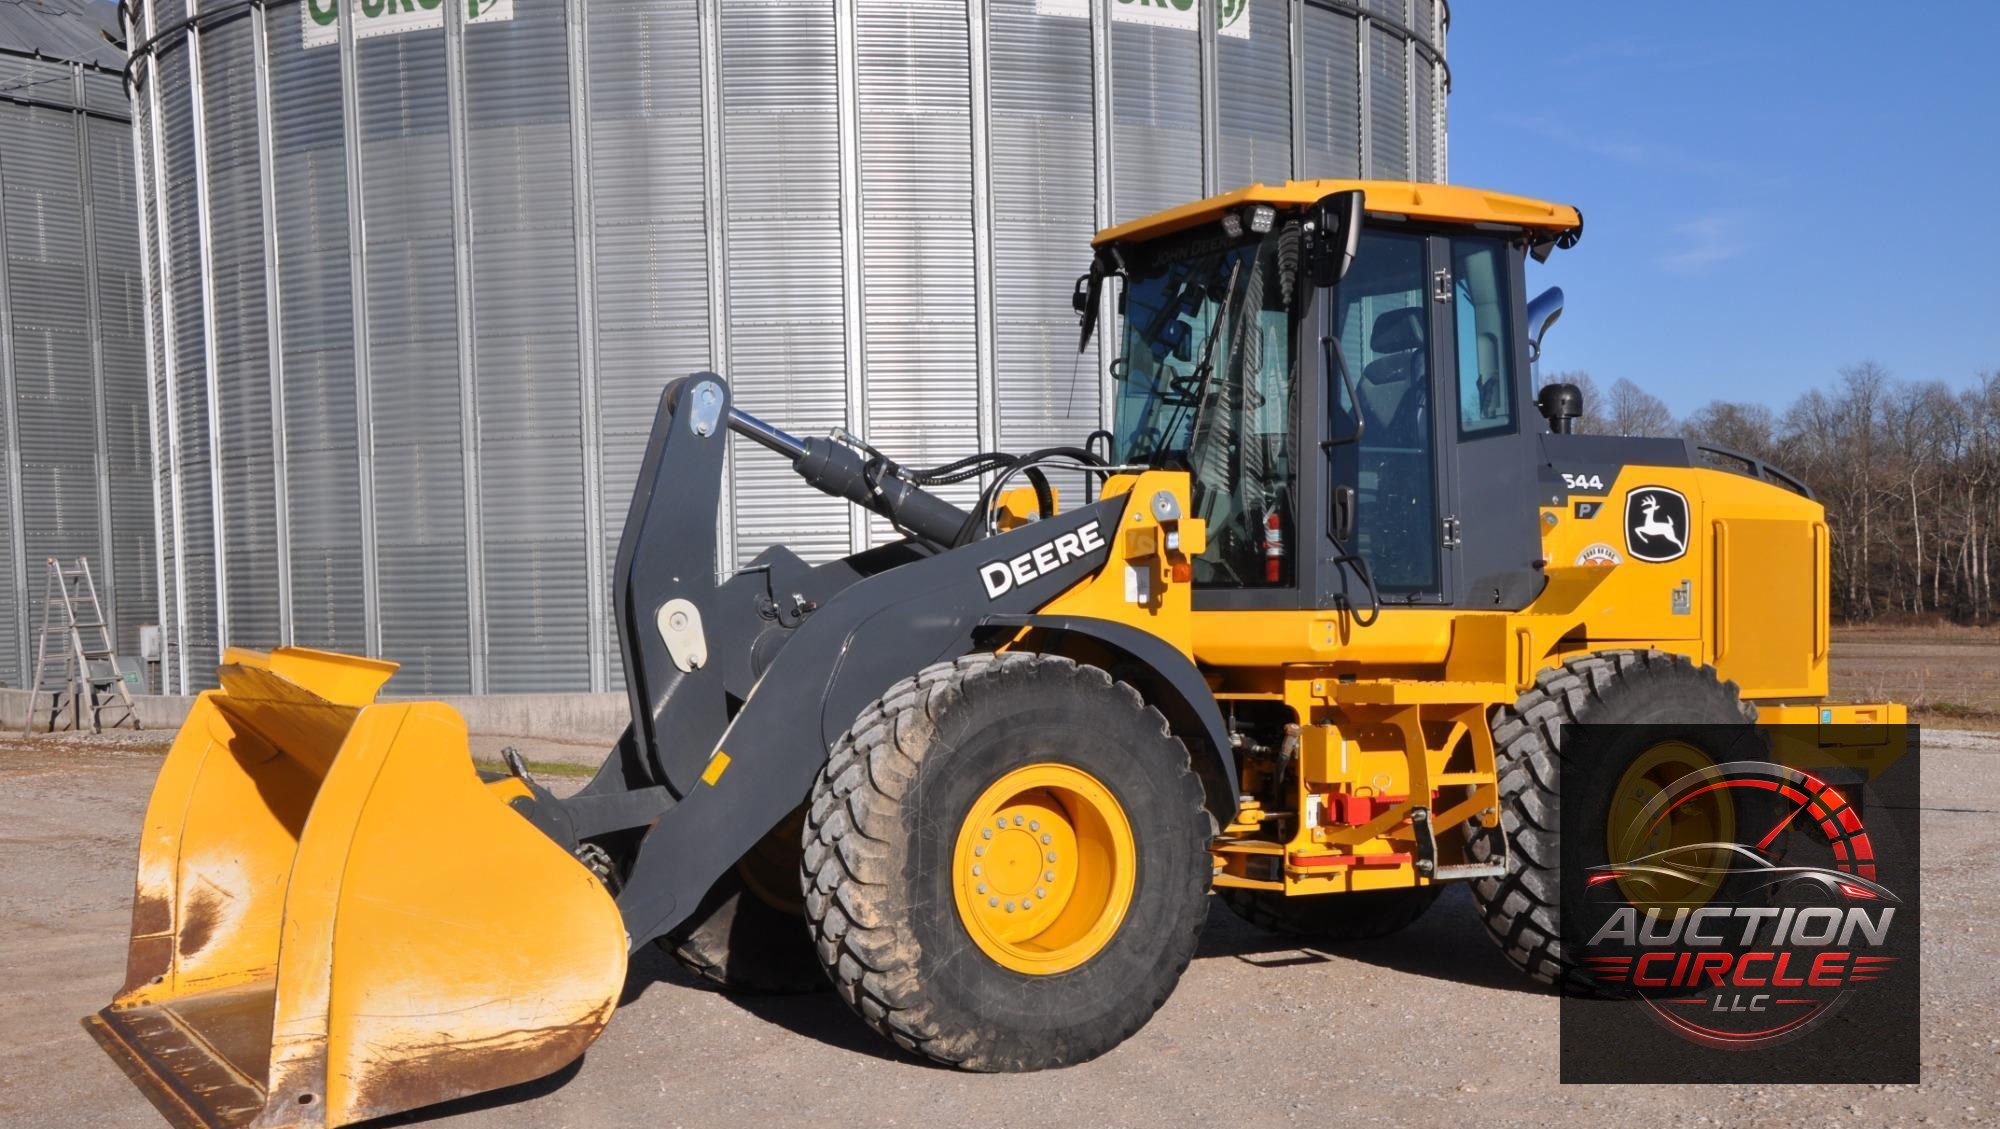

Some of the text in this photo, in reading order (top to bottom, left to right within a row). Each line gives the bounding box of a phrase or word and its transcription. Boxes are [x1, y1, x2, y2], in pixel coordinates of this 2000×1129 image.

[1562, 474, 1603, 490] 544
[1579, 503, 1592, 518] P
[980, 521, 1105, 599] DEERE
